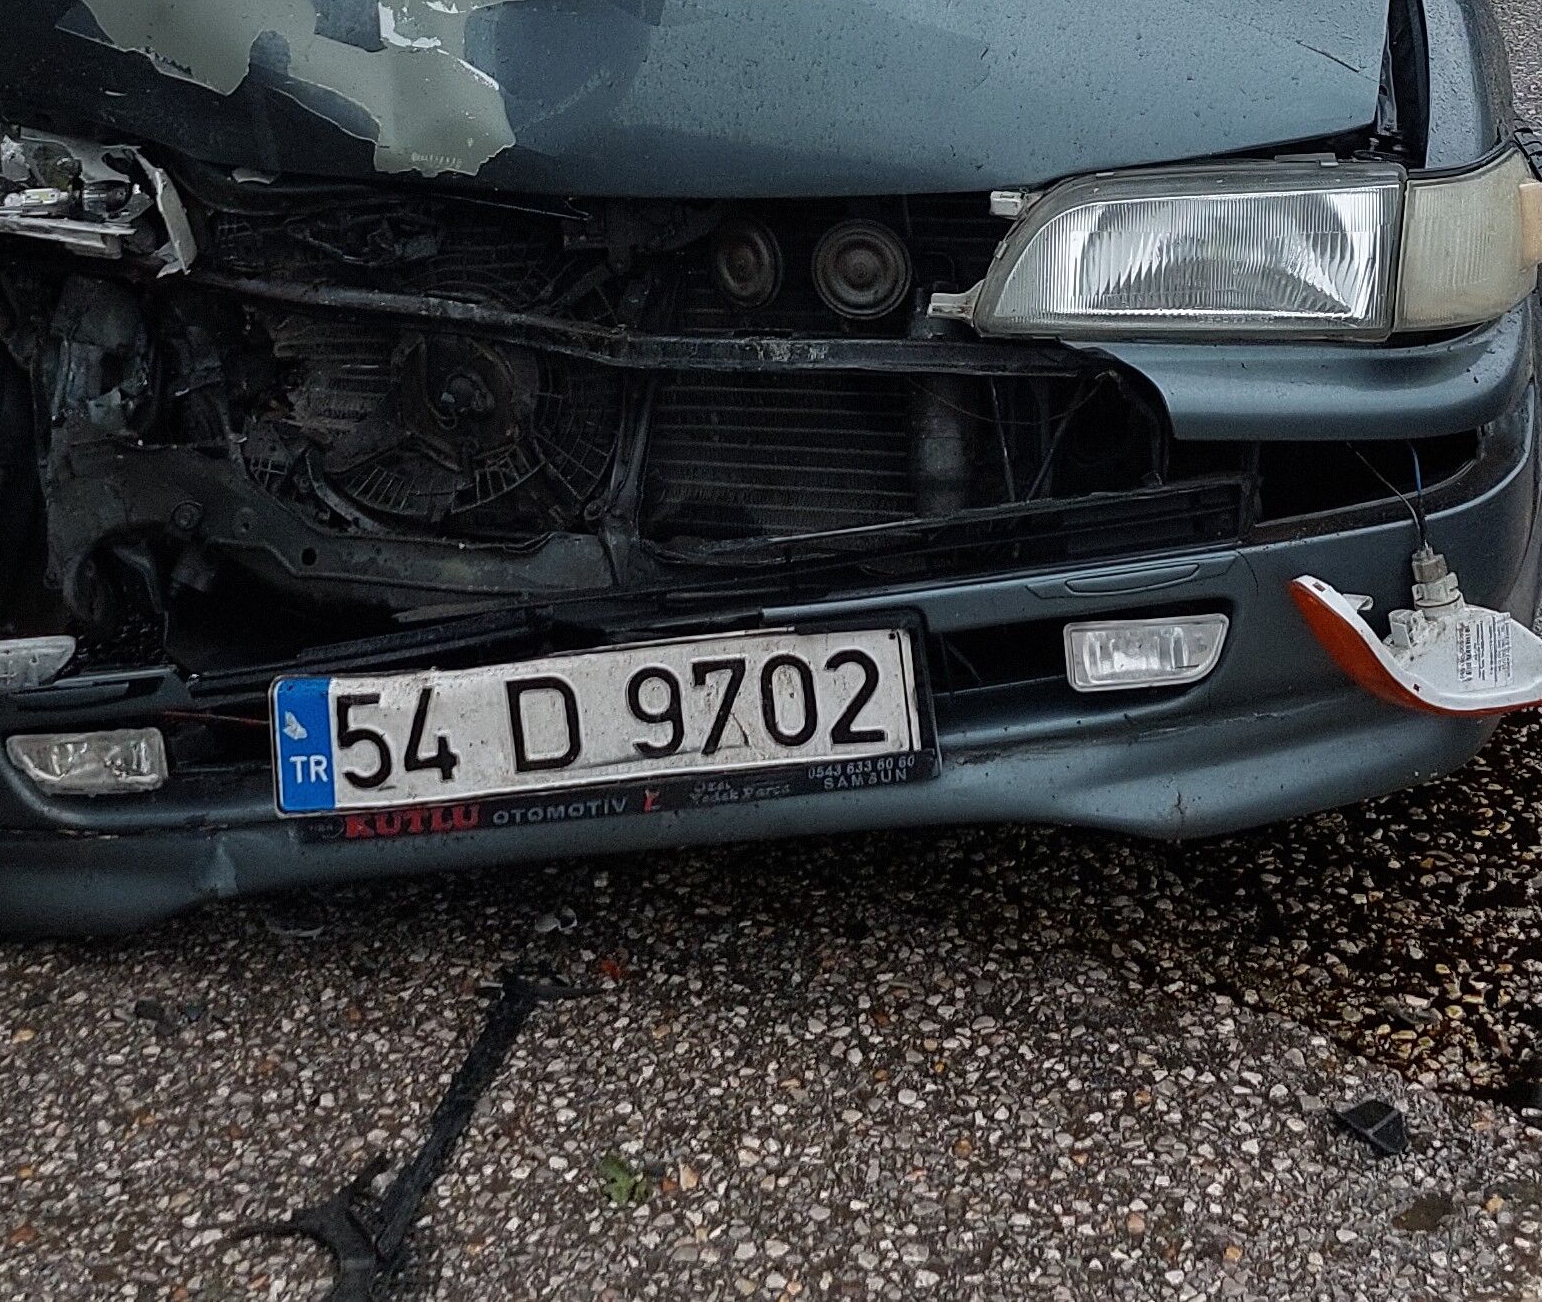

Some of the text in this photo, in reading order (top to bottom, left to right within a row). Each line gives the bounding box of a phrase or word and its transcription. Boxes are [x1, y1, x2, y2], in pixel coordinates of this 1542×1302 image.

[336, 648, 886, 789] 54 D 9702
[290, 754, 328, 785] TR
[823, 768, 907, 791] SAMSUN
[344, 803, 481, 839] KUTLU
